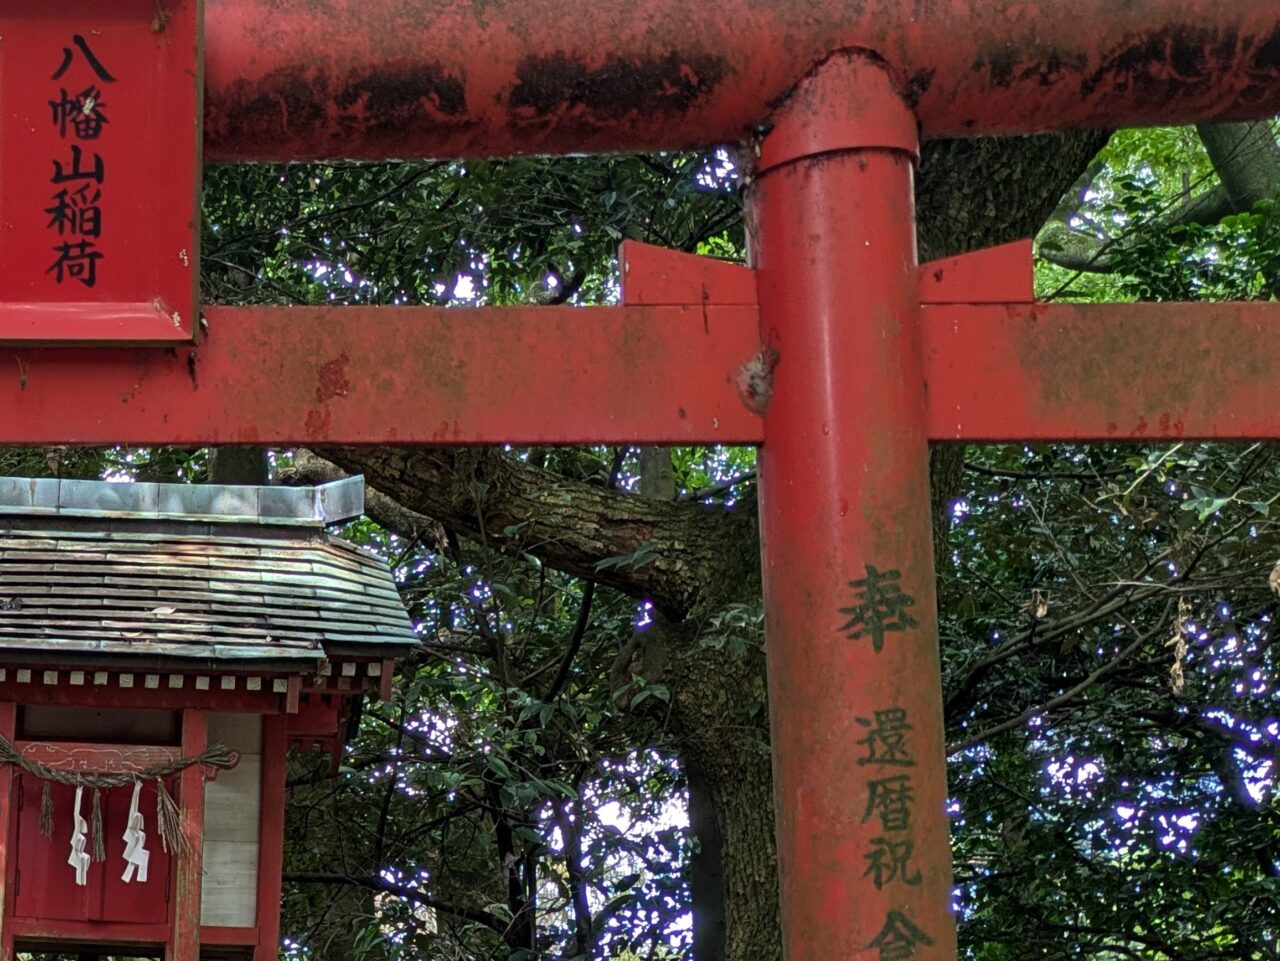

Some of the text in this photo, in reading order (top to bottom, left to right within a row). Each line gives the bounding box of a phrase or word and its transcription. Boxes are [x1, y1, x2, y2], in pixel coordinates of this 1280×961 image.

[44, 33, 118, 288] 八幡山稲荷
[837, 564, 918, 654] 奉
[853, 708, 921, 892] 還暦祝
